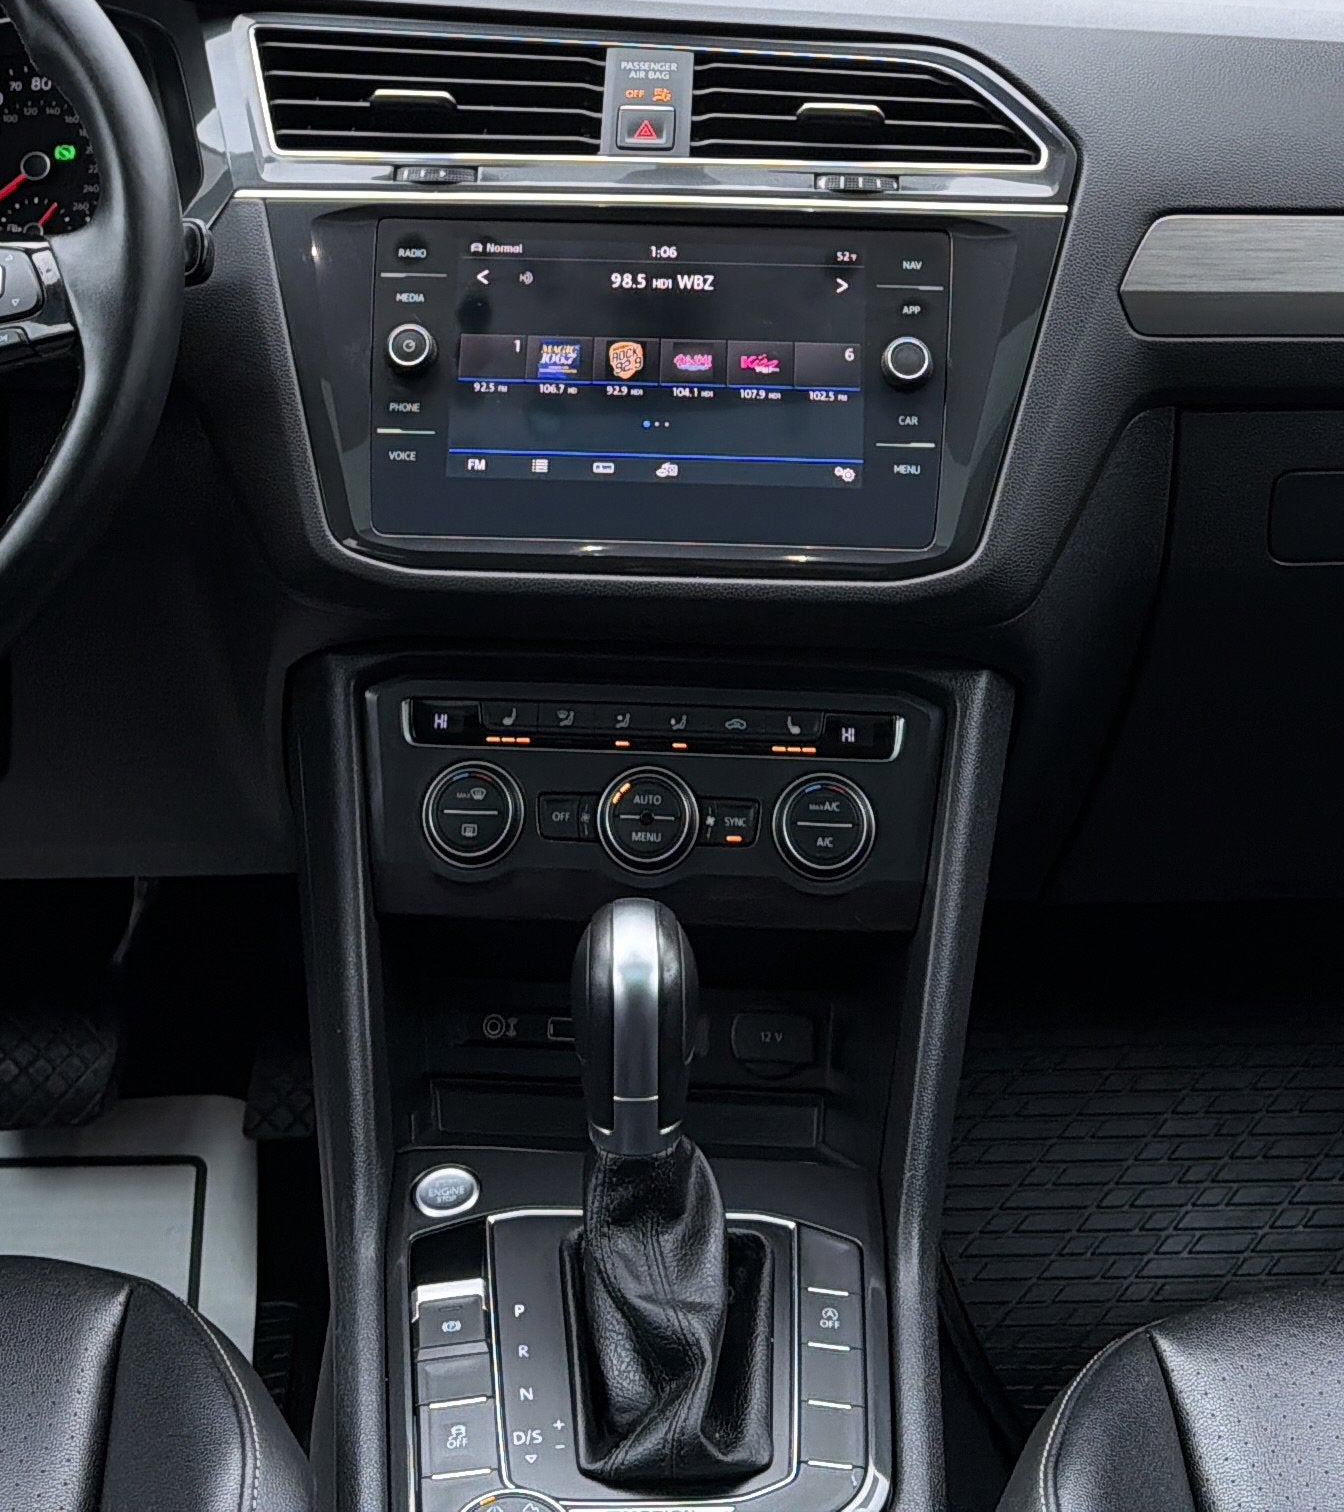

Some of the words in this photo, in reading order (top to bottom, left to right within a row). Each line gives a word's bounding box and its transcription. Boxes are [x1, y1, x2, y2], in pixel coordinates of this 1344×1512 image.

[620, 61, 678, 72] PASSENGER
[629, 71, 646, 79] AIR
[648, 71, 670, 80] BAG
[9, 81, 23, 92] 70
[31, 76, 52, 91] 80
[625, 89, 646, 99] OFF
[23, 107, 38, 115] 120
[2, 114, 18, 123] 100
[398, 248, 427, 259] RADIO
[486, 243, 523, 254] Normal
[650, 246, 678, 258] 1:06
[902, 260, 923, 270] NAV
[611, 273, 647, 288] 98.5
[653, 278, 673, 289] HD1
[677, 275, 715, 290] WBZ
[396, 293, 425, 303] MEDIA
[902, 306, 921, 315] APP
[612, 346, 639, 361] ROCK
[844, 348, 855, 362] 6
[474, 382, 495, 393] 92.5
[539, 384, 565, 394] 106.7
[606, 386, 628, 396] 92.9
[672, 387, 698, 397] 104.1
[740, 389, 766, 399] 107.9
[809, 391, 835, 402] 102.5
[389, 402, 421, 413] PHONE
[898, 416, 919, 426] CAR
[388, 451, 417, 461] VOICE
[467, 458, 486, 471] FM
[893, 464, 921, 475] MENU
[433, 713, 448, 730] HI
[841, 727, 855, 743] HI
[633, 794, 662, 805] AUTO
[824, 801, 841, 813] A/C
[552, 811, 571, 822] OFF
[724, 817, 747, 827] SYNC
[631, 831, 662, 842] MENU
[816, 837, 834, 848] A/C
[428, 1185, 465, 1197] ENGINE
[437, 1194, 457, 1203] STOP
[514, 1304, 525, 1318] P
[819, 1319, 840, 1329] OFF
[518, 1344, 529, 1358] R
[519, 1387, 534, 1401] N
[446, 1436, 468, 1449] OFF
[512, 1429, 543, 1445] D/S
